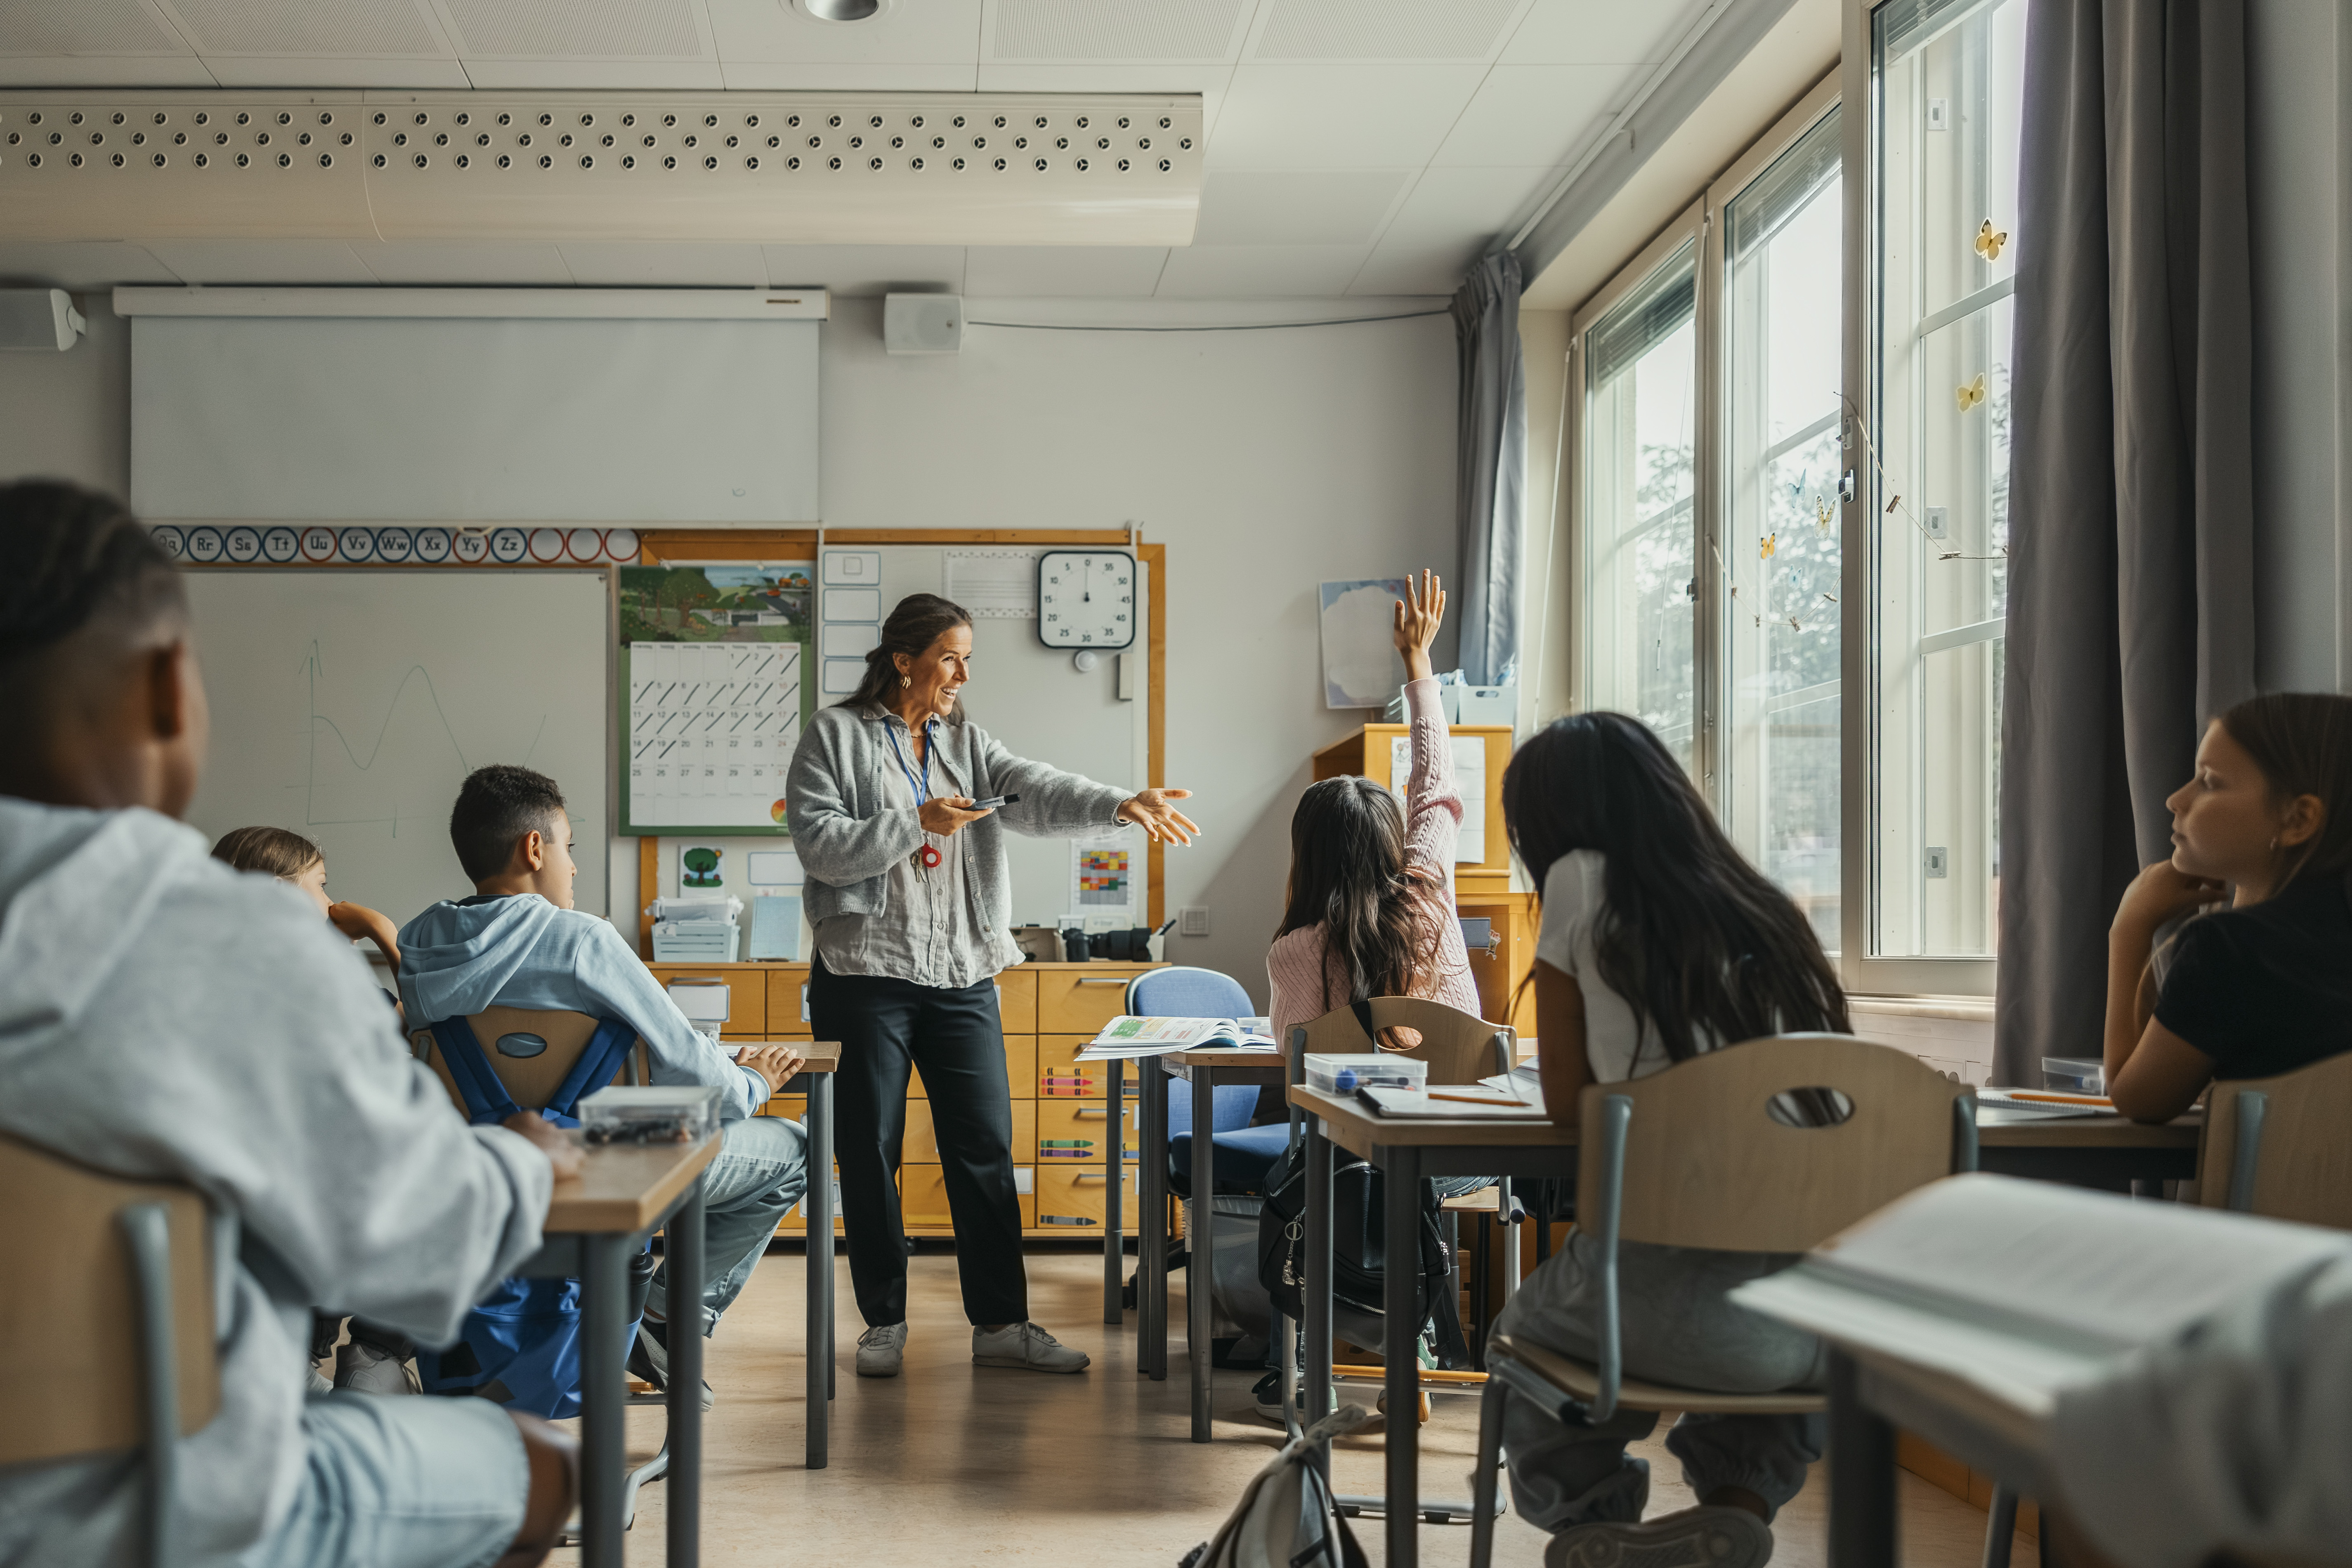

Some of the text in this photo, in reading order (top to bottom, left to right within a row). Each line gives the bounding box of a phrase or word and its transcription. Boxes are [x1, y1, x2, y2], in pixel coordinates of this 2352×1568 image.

[197, 538, 213, 551] Rr
[235, 538, 251, 551] Ss
[272, 538, 289, 551] Tt
[310, 537, 328, 550] Uu
[349, 537, 366, 550] Vv
[381, 538, 407, 550] Ww
[425, 537, 441, 550] Xx
[462, 538, 480, 553] Yy
[501, 537, 517, 551] Zz
